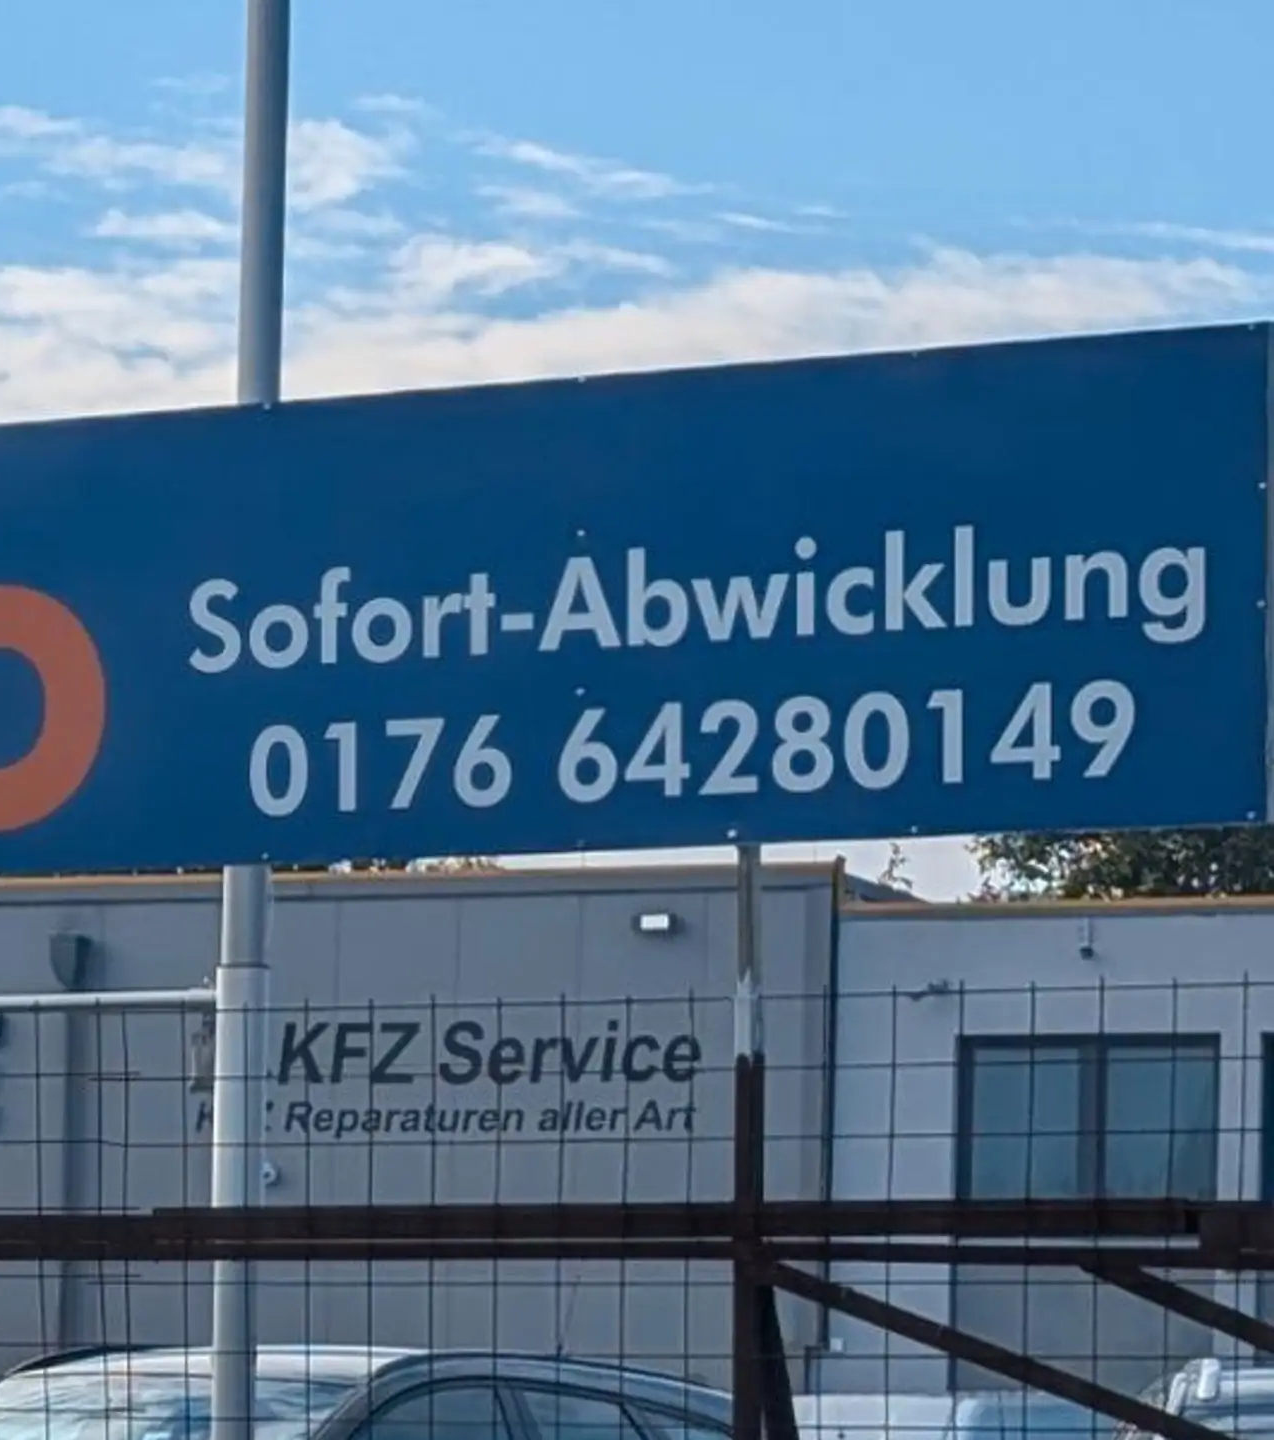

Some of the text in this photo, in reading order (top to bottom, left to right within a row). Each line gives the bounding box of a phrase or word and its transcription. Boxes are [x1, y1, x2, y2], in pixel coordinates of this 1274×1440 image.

[187, 525, 1208, 673] Sofort-Abwicklung
[248, 679, 1137, 818] 0176 64280149
[276, 1018, 702, 1085] KFZ Service
[284, 1100, 524, 1140] Reparaturen
[537, 1100, 627, 1133] aller
[630, 1100, 697, 1133] Art
